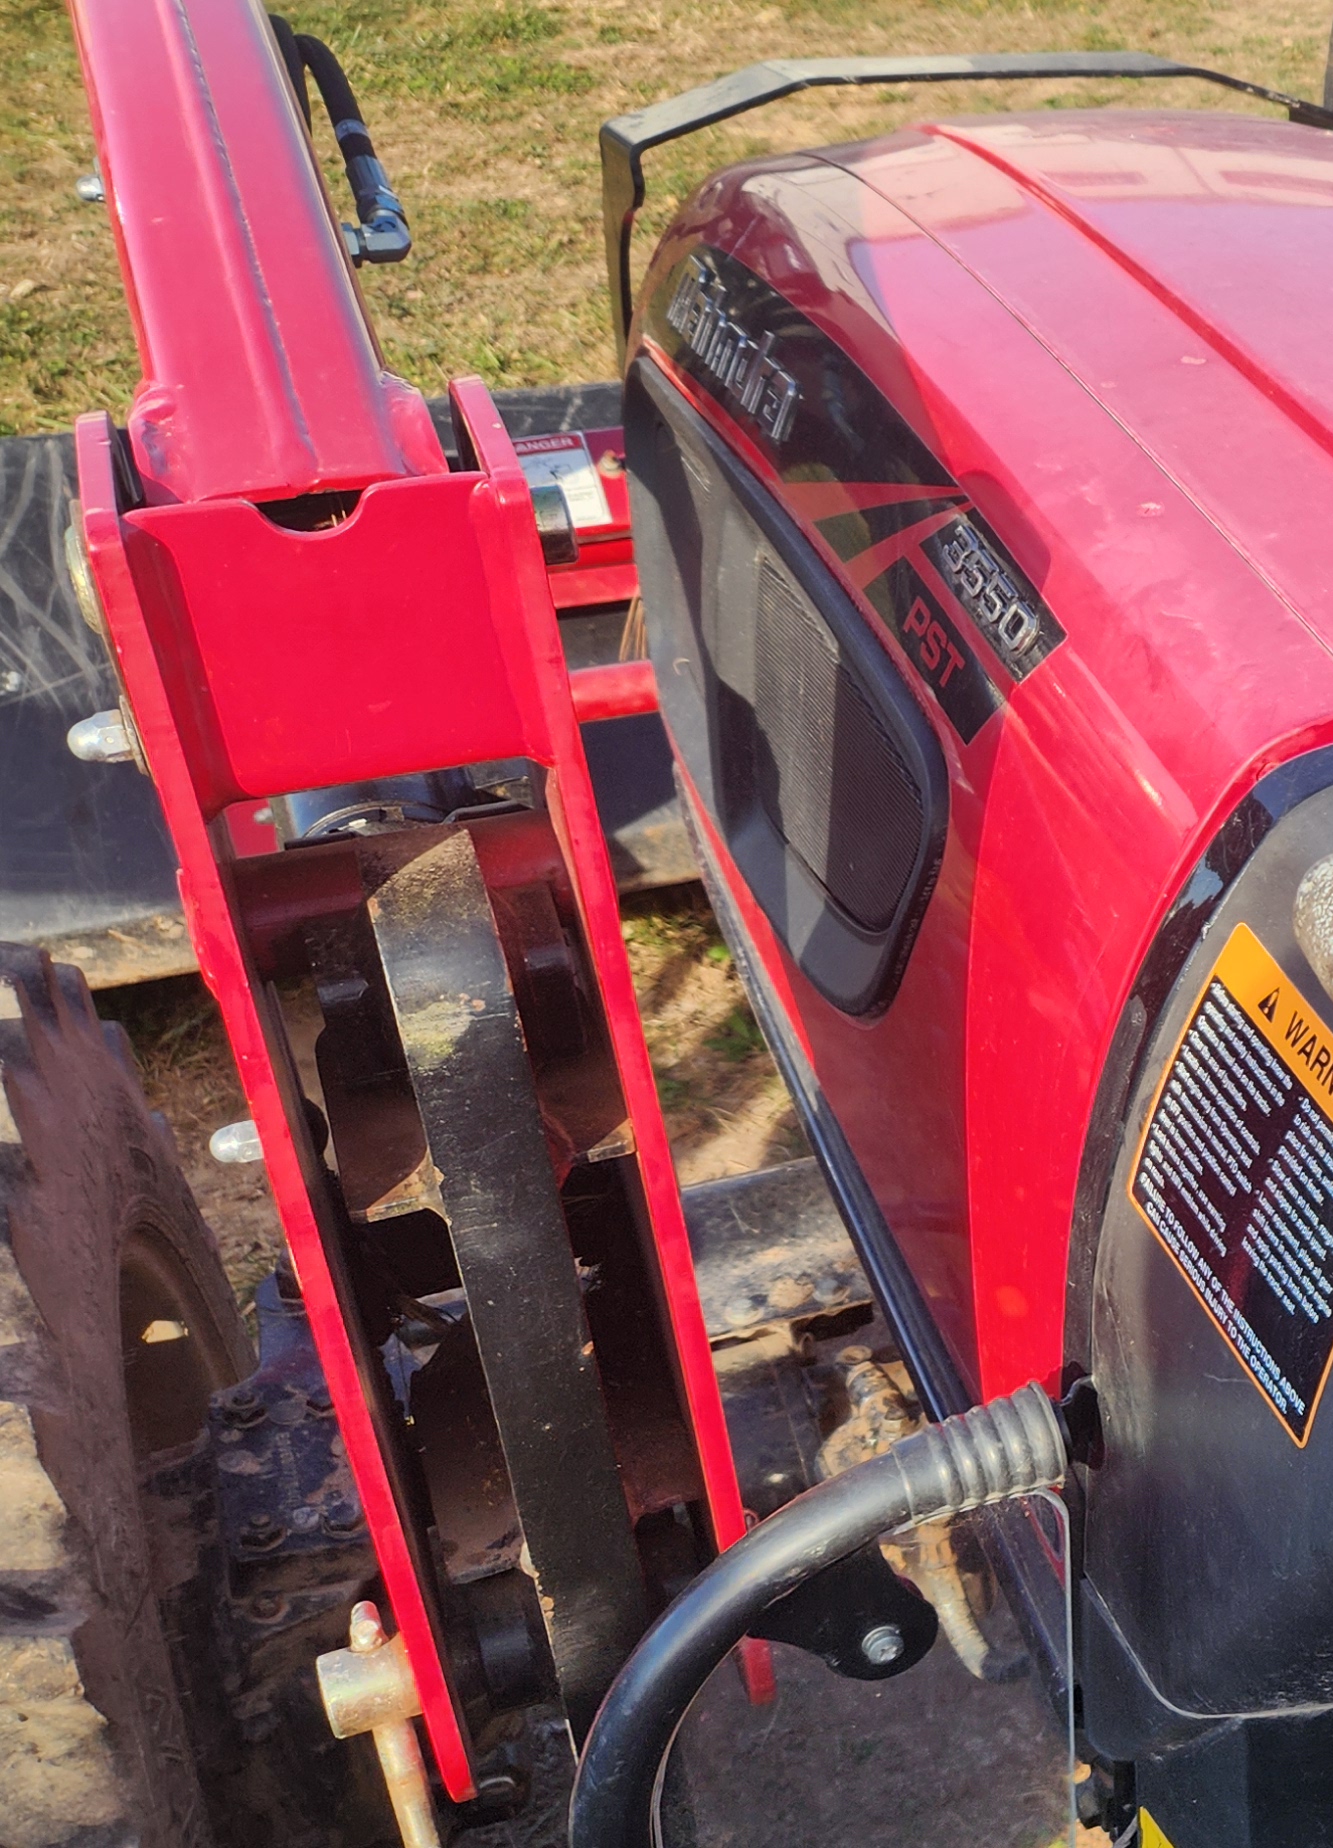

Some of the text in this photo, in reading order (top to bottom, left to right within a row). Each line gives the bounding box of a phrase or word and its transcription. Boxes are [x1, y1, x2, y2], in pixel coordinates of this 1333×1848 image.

[516, 436, 575, 453] ANGER
[942, 524, 1041, 657] 3550
[902, 596, 966, 688] PST
